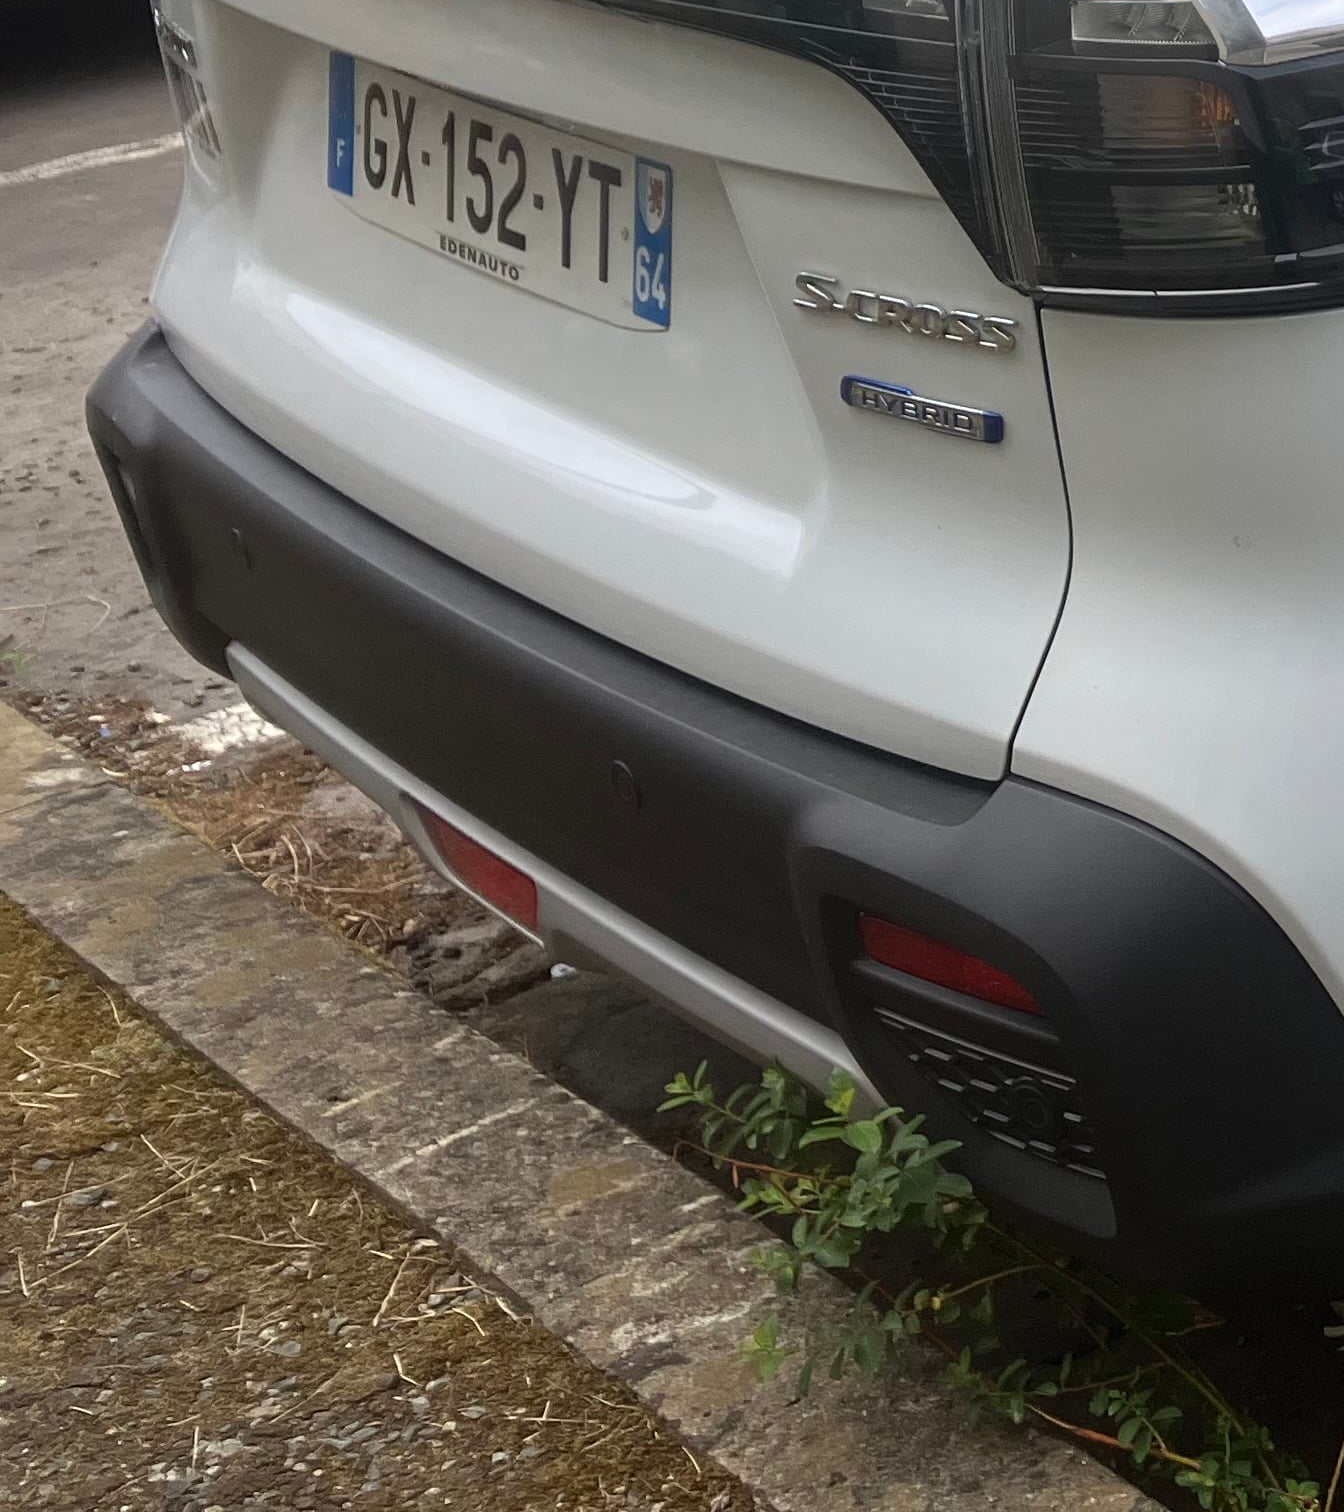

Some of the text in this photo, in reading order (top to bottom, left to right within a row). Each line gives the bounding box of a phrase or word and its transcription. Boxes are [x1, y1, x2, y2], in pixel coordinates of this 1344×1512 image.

[336, 139, 345, 167] F
[363, 82, 622, 284] GX-152-YT
[439, 235, 520, 281] EDENAUTO
[635, 245, 666, 311] 64
[861, 390, 974, 433] HYBRID
